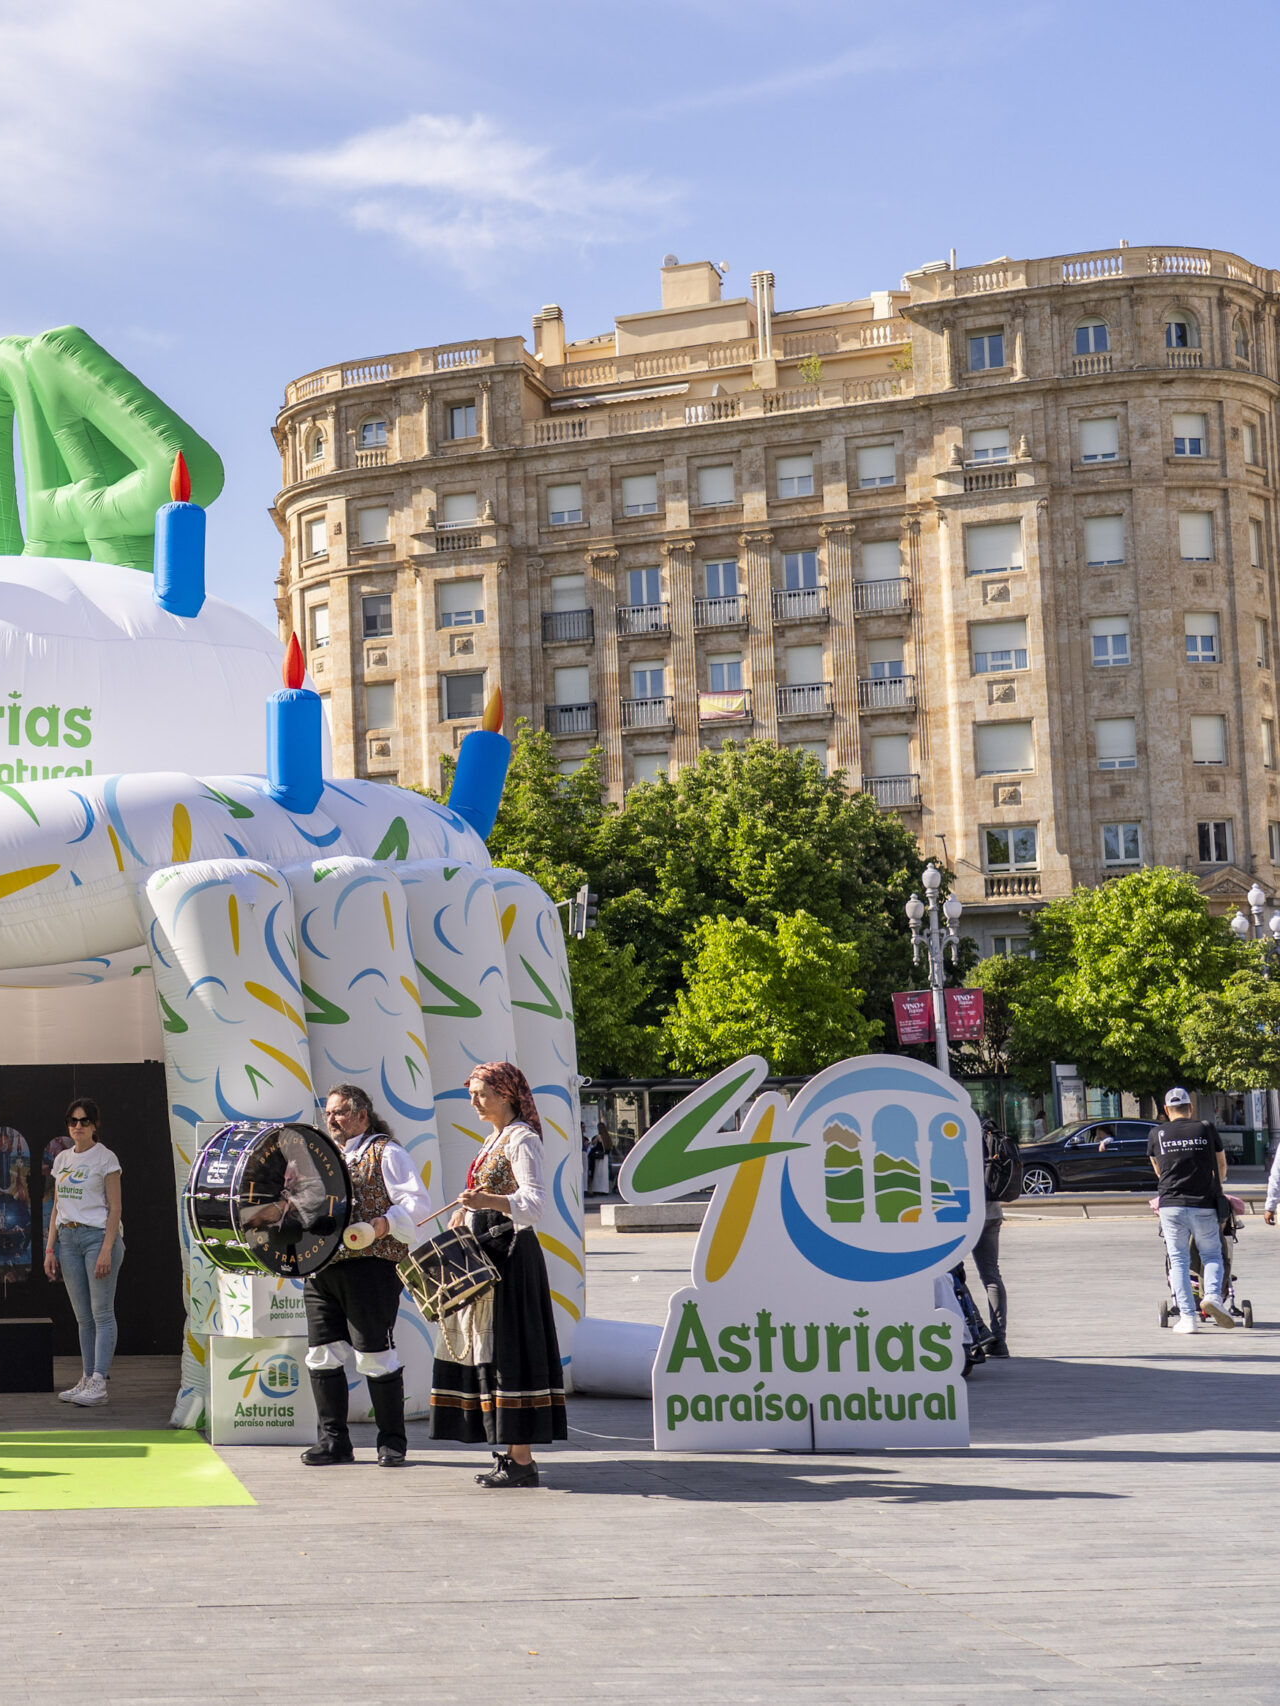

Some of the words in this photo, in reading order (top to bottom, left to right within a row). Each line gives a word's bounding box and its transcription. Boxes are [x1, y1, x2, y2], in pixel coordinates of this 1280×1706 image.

[293, 1137, 305, 1145] DE
[1162, 1137, 1208, 1148] traspatio
[274, 1237, 325, 1263] TRASGOS
[270, 1295, 305, 1310] Asturi
[666, 1300, 953, 1373] Asturias
[234, 1402, 295, 1417] Asturias
[666, 1381, 808, 1431] paraíso
[820, 1384, 957, 1421] natural
[233, 1418, 264, 1428] paraíso
[265, 1419, 295, 1427] natural
